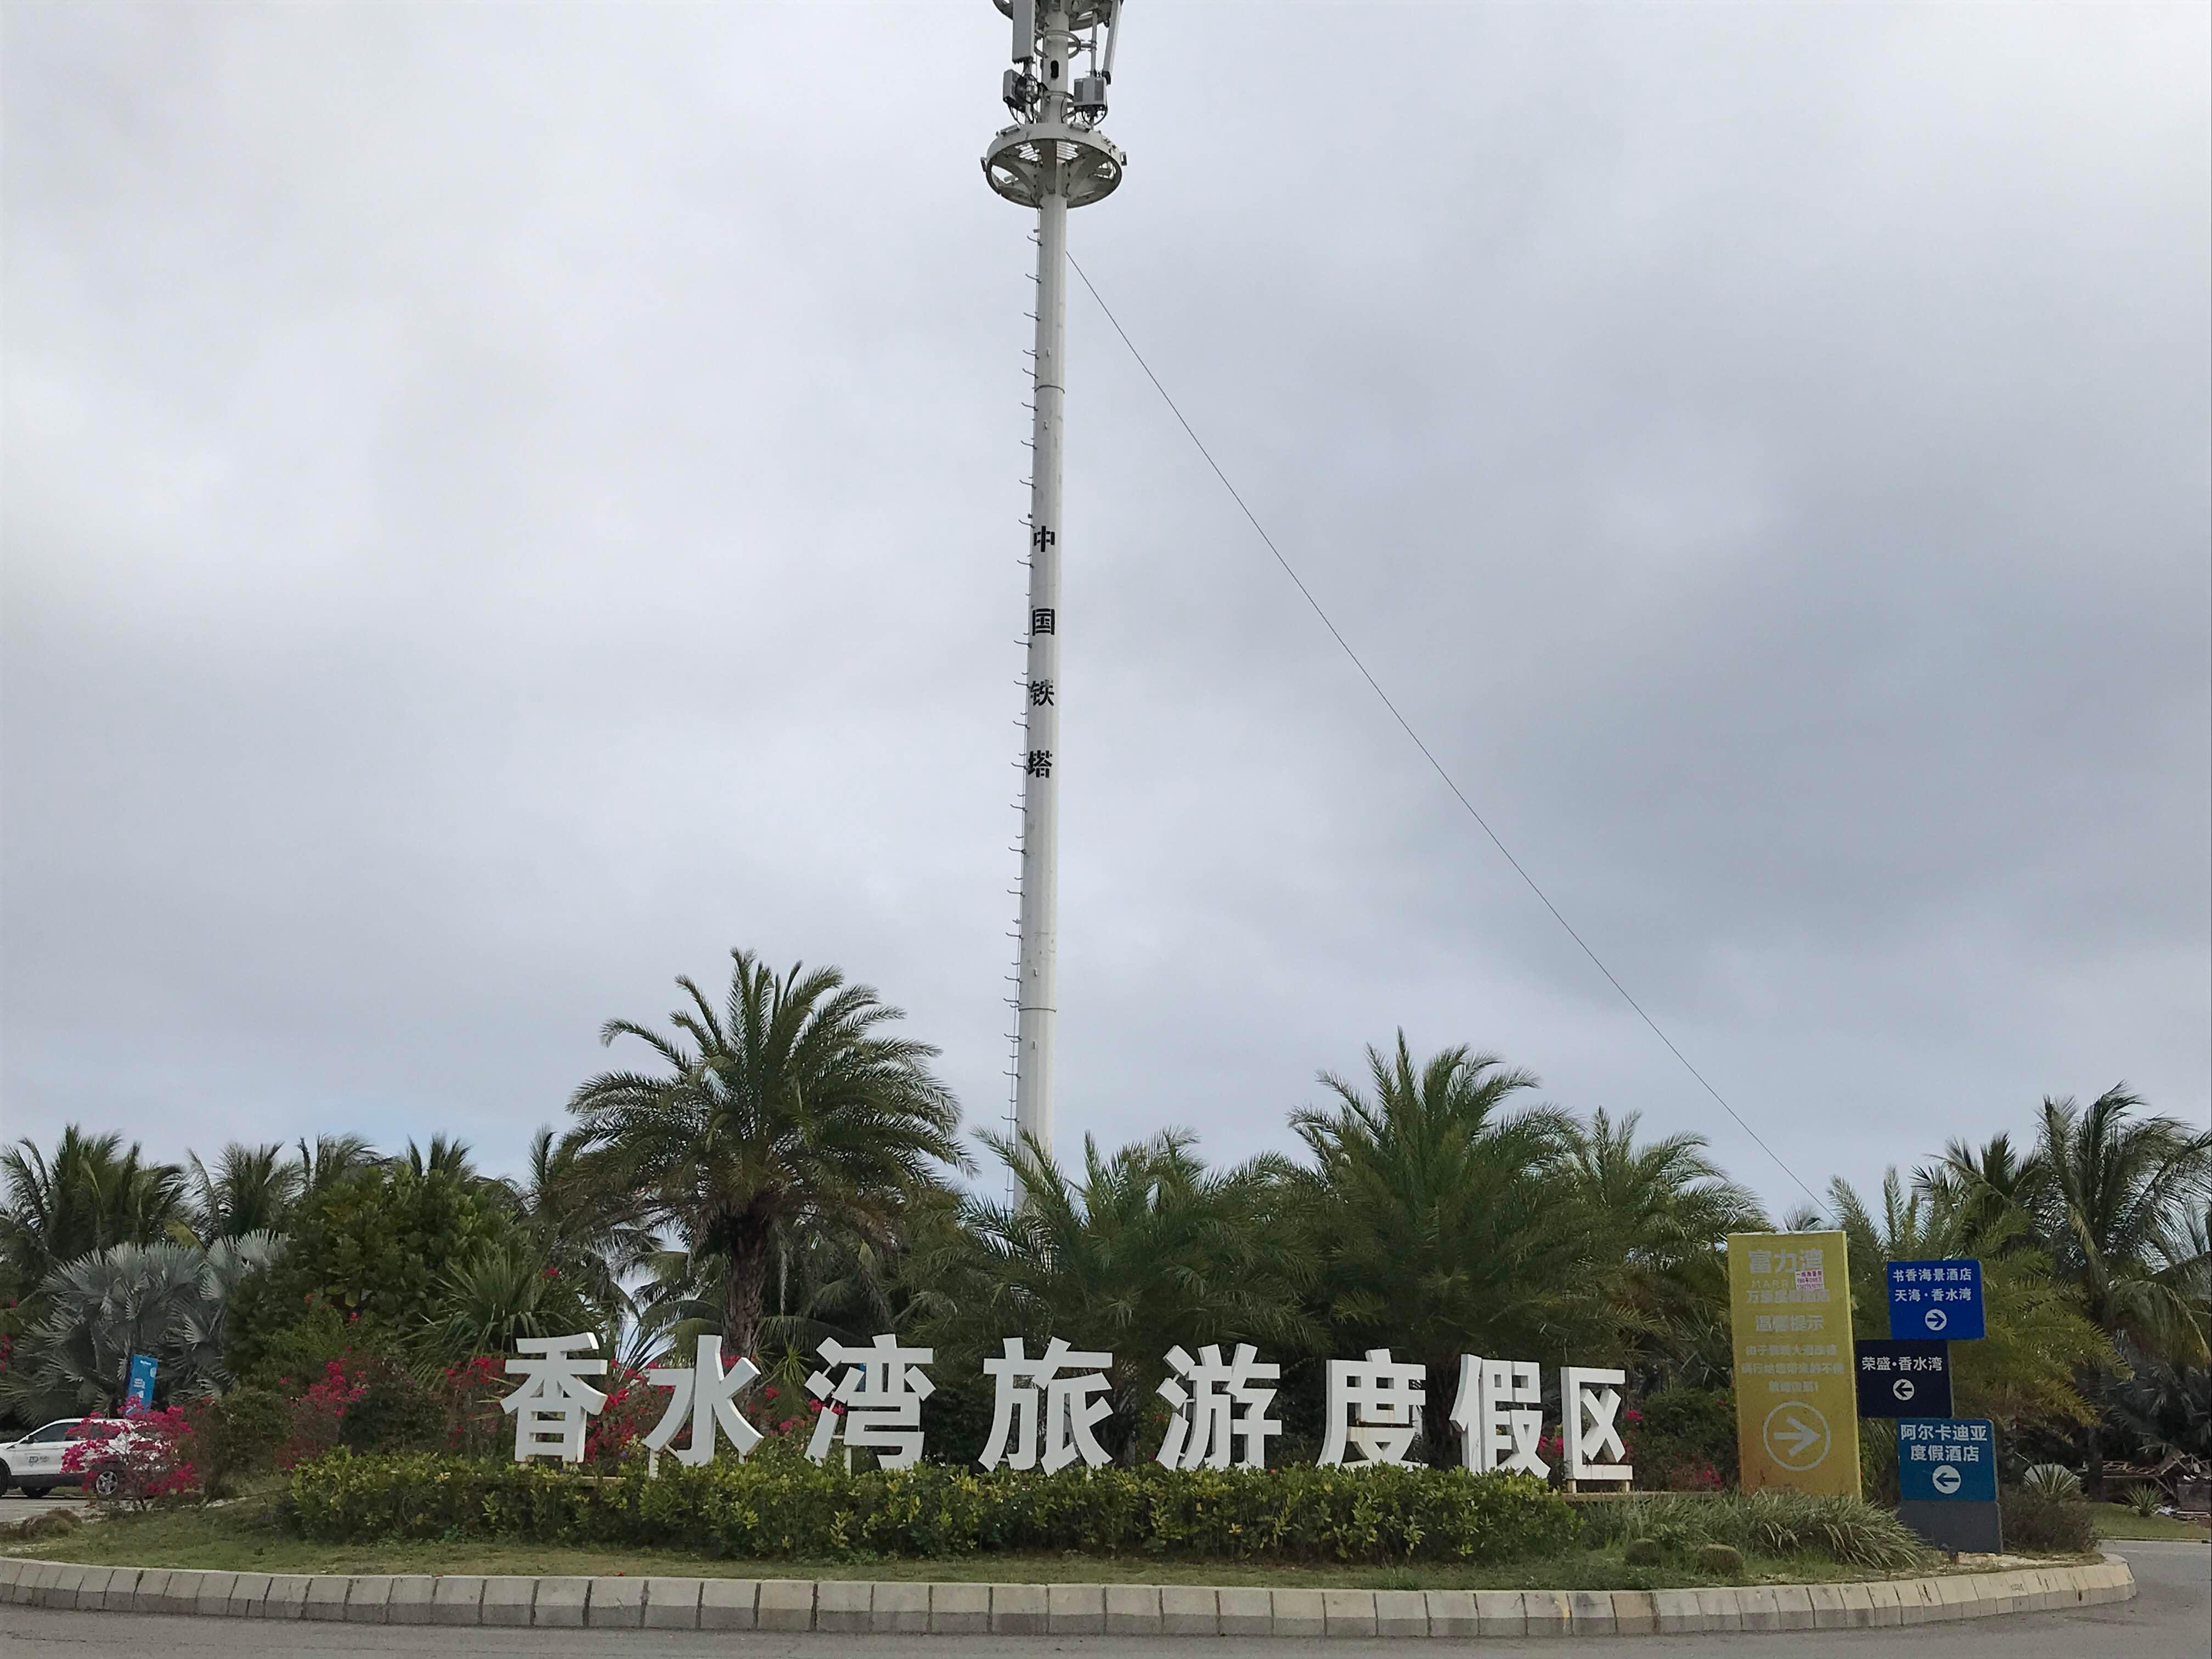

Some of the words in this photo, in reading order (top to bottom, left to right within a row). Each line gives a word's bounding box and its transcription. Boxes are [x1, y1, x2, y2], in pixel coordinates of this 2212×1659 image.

[1027, 525, 1056, 778] 中国铁塔
[1748, 1248, 1823, 1273] 富力湾
[1893, 1268, 1972, 1283] 书香海景酒店
[1894, 1287, 1972, 1302] 天海·香水湾
[1861, 1356, 1943, 1371] 荣盛·香水湾
[500, 1332, 1634, 1480] 香水湾旅游度假区
[1900, 1424, 1988, 1441] 阿尔卡迪亚
[1910, 1444, 1979, 1462] 度假酒店
